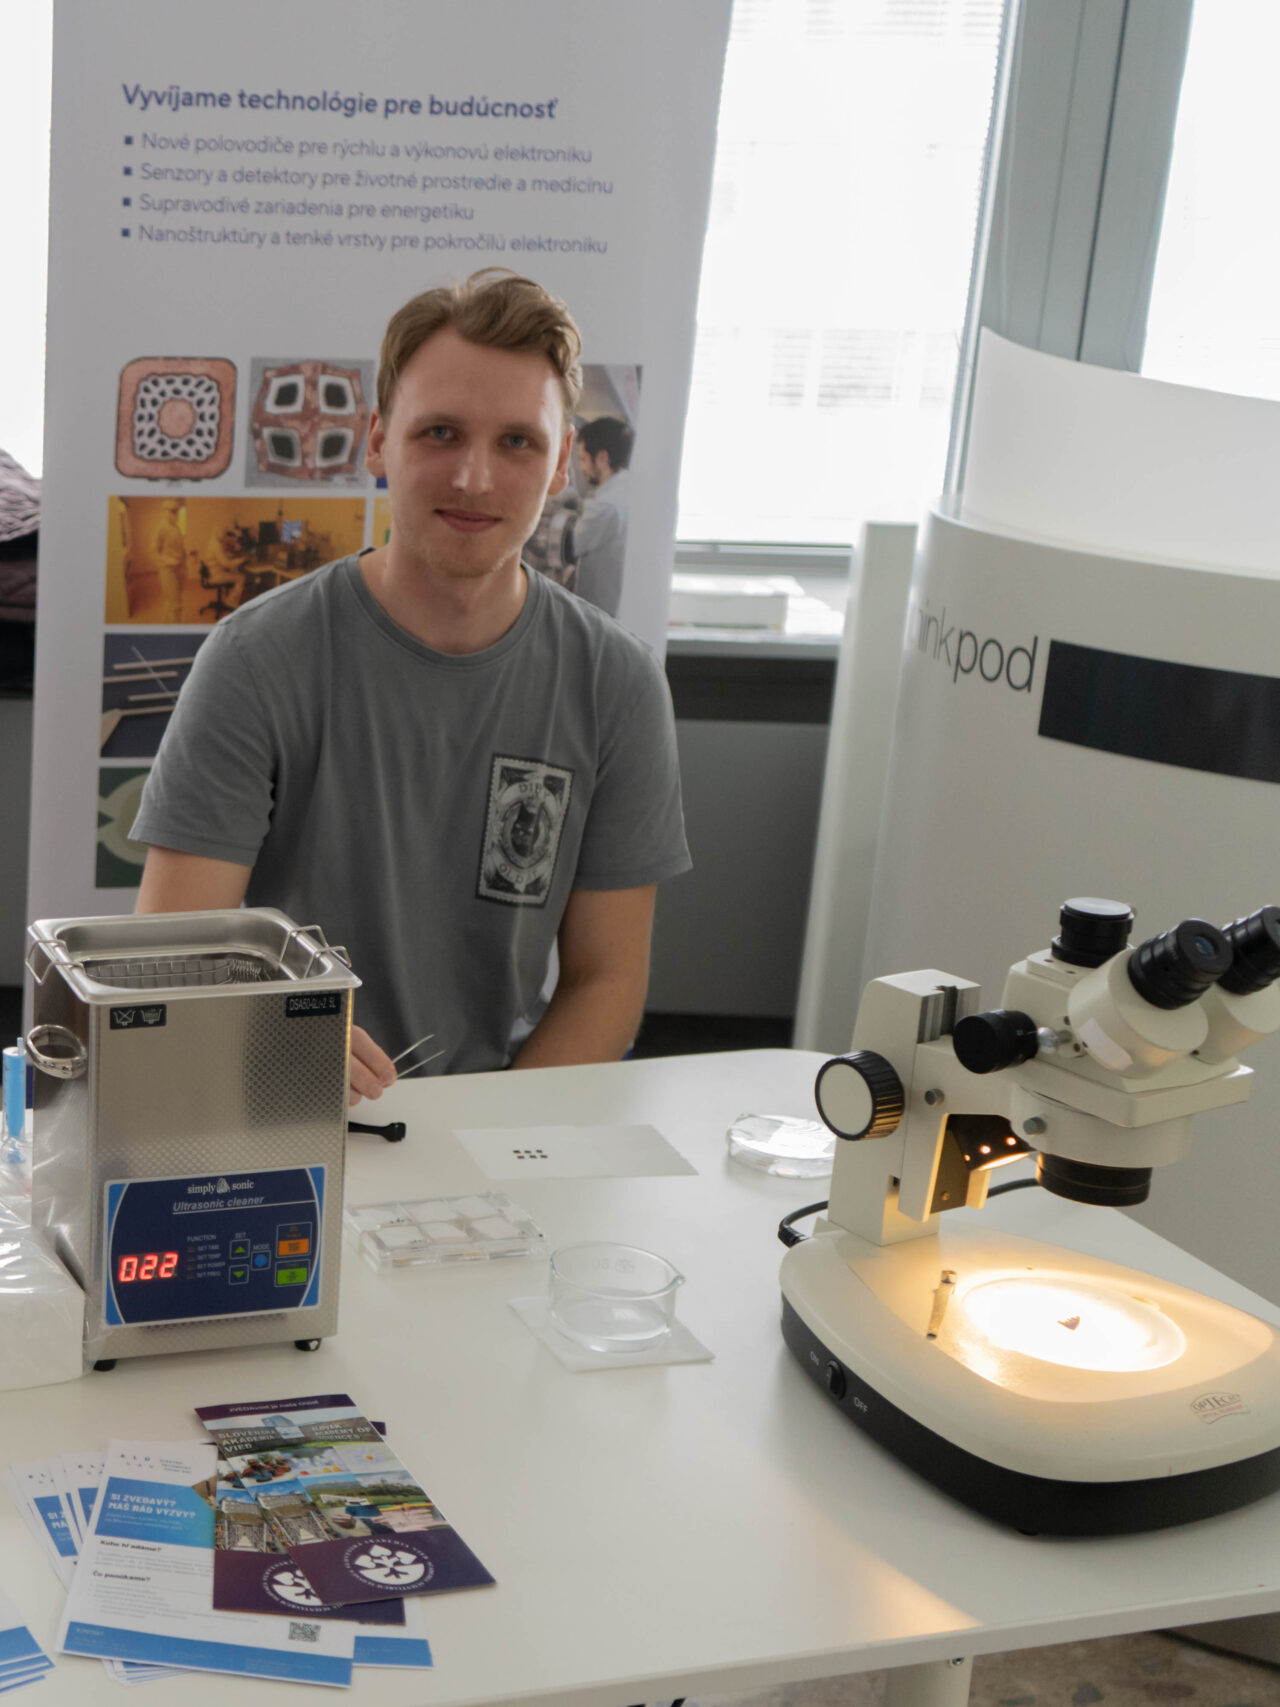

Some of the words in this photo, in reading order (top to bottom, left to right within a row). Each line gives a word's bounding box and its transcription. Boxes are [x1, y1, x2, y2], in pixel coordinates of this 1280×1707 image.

[122, 84, 232, 112] Vyvíjame
[238, 89, 378, 118] technológie
[384, 98, 422, 119] pre
[429, 94, 558, 119] budúcnosť
[142, 132, 190, 151] Nové
[195, 135, 294, 155] polovodiče
[298, 141, 328, 158] pre
[332, 139, 385, 160] rýchlu
[390, 145, 400, 157] a
[404, 141, 489, 161] výkonovú
[494, 144, 592, 164] elektroniku
[140, 162, 213, 186] Senzory
[217, 171, 227, 183] a
[232, 165, 318, 189] detektory
[321, 171, 351, 192] pre
[354, 170, 417, 189] životné
[422, 173, 512, 194] prostredie
[516, 181, 527, 192] a
[532, 177, 614, 195] medicínu
[139, 193, 251, 215] Supravodivé
[254, 198, 343, 216] zariadenia
[348, 204, 376, 220] pre
[381, 202, 474, 222] energetiku
[138, 225, 267, 248] Nanoštruktúry
[270, 233, 280, 245] a
[286, 230, 333, 246] tenké
[338, 232, 387, 249] vrstvy
[392, 234, 420, 250] pre
[424, 233, 506, 252] pokročilú
[510, 236, 608, 254] elektroniku
[187, 1182, 216, 1195] simply
[231, 1179, 255, 1191] sonic
[172, 1198, 225, 1212] Ultrasonic
[226, 1196, 265, 1207] cleaner
[187, 1234, 217, 1242] FUNCTION
[119, 1252, 179, 1282] 022
[853, 1396, 869, 1414] OFF
[224, 1443, 253, 1453] VIED
